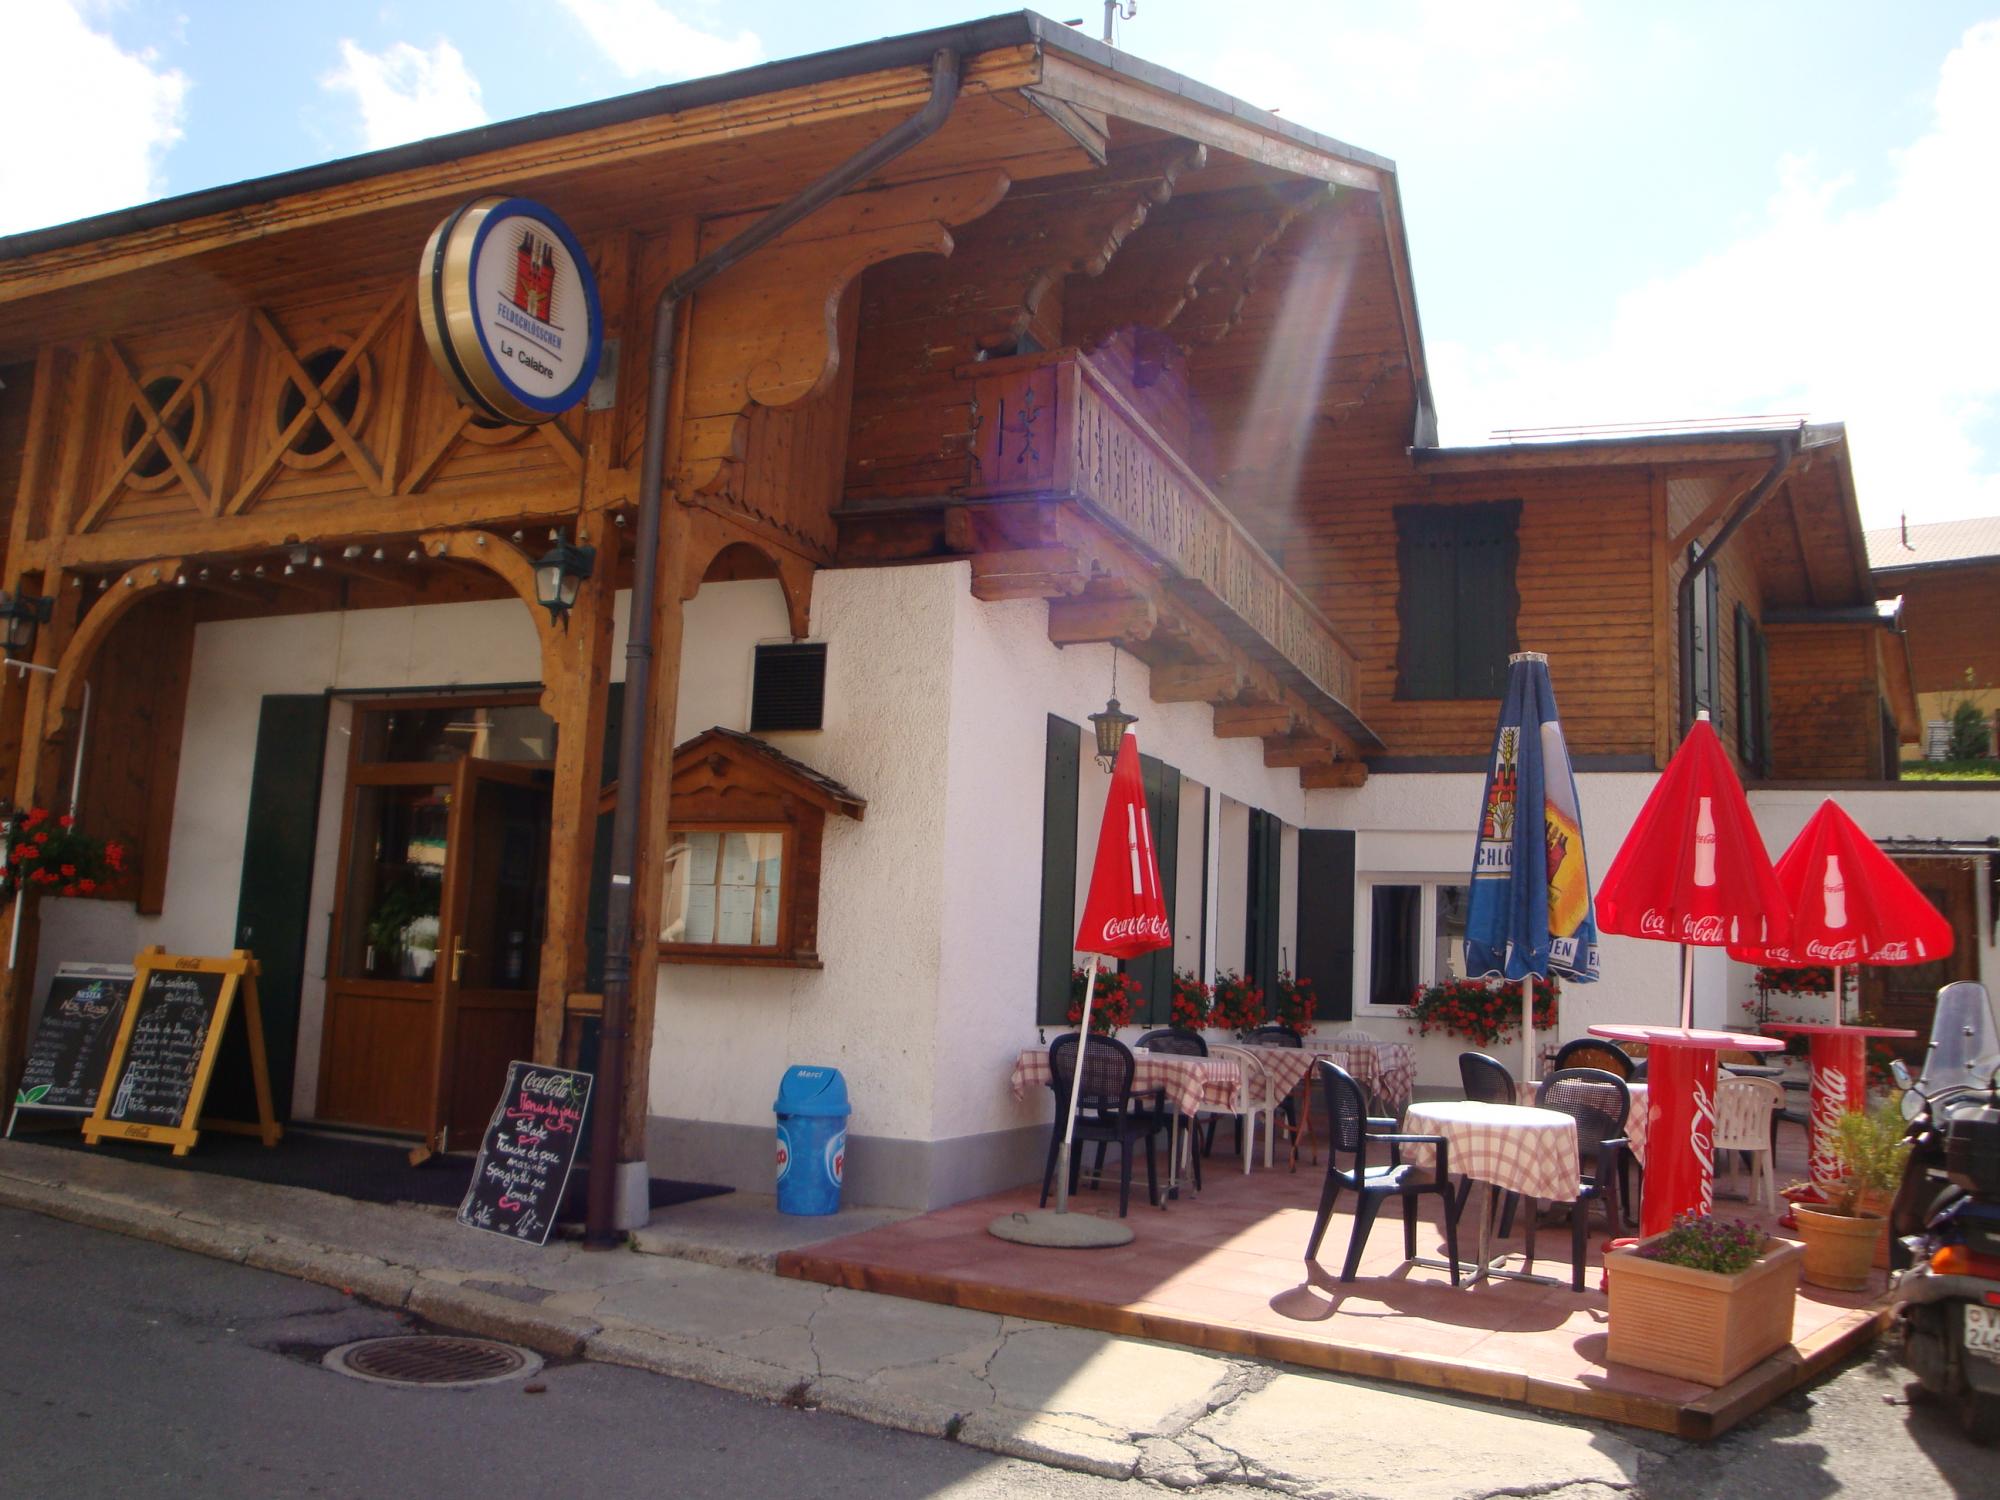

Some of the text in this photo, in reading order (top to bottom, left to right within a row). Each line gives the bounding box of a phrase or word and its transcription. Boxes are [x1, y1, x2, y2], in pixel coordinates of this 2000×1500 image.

[497, 302, 562, 350] FELDSCHLÖSSCHEN
[500, 340, 554, 379] La Calabre
[797, 1070, 823, 1078] Merci
[515, 1119, 549, 1141] Salade
[527, 1144, 538, 1161] de
